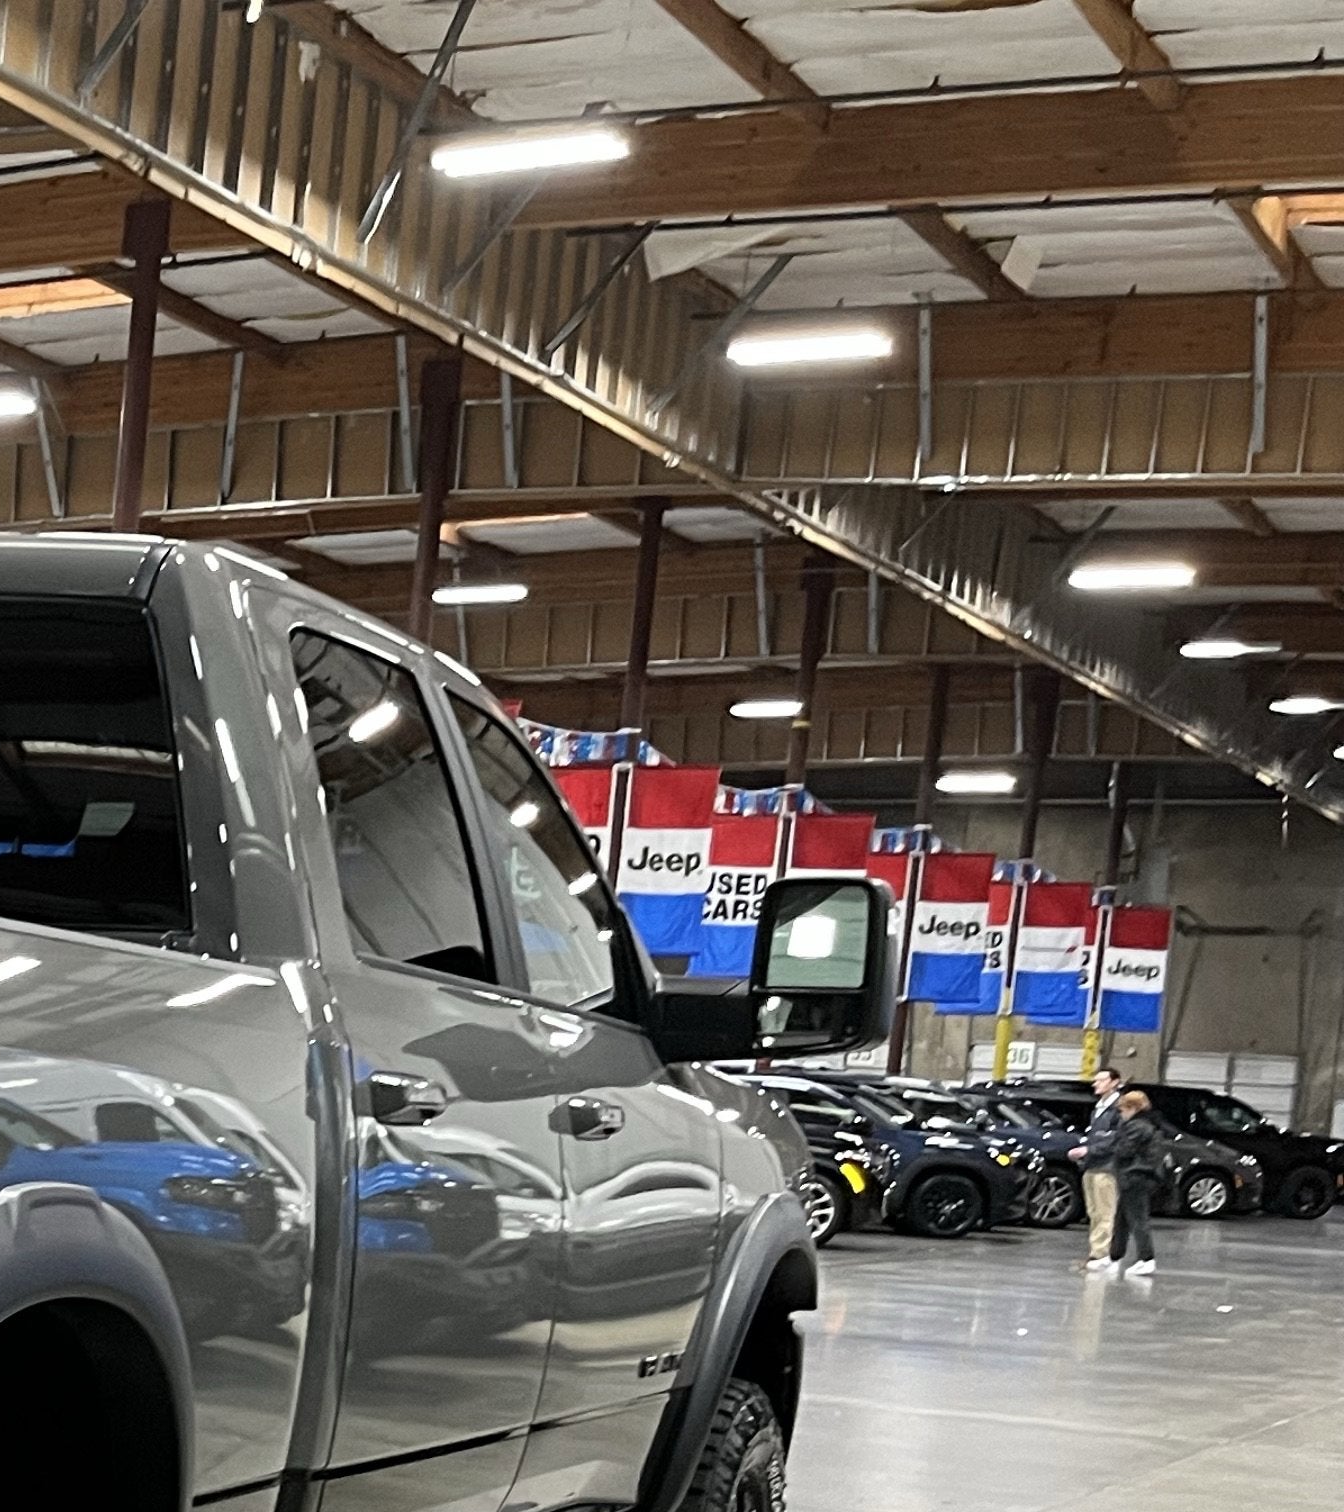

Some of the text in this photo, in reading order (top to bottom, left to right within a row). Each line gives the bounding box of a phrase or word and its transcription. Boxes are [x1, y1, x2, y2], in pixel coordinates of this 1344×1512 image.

[627, 846, 701, 878] Jeep
[918, 914, 981, 940] Jeep
[1107, 957, 1162, 982] Jeep
